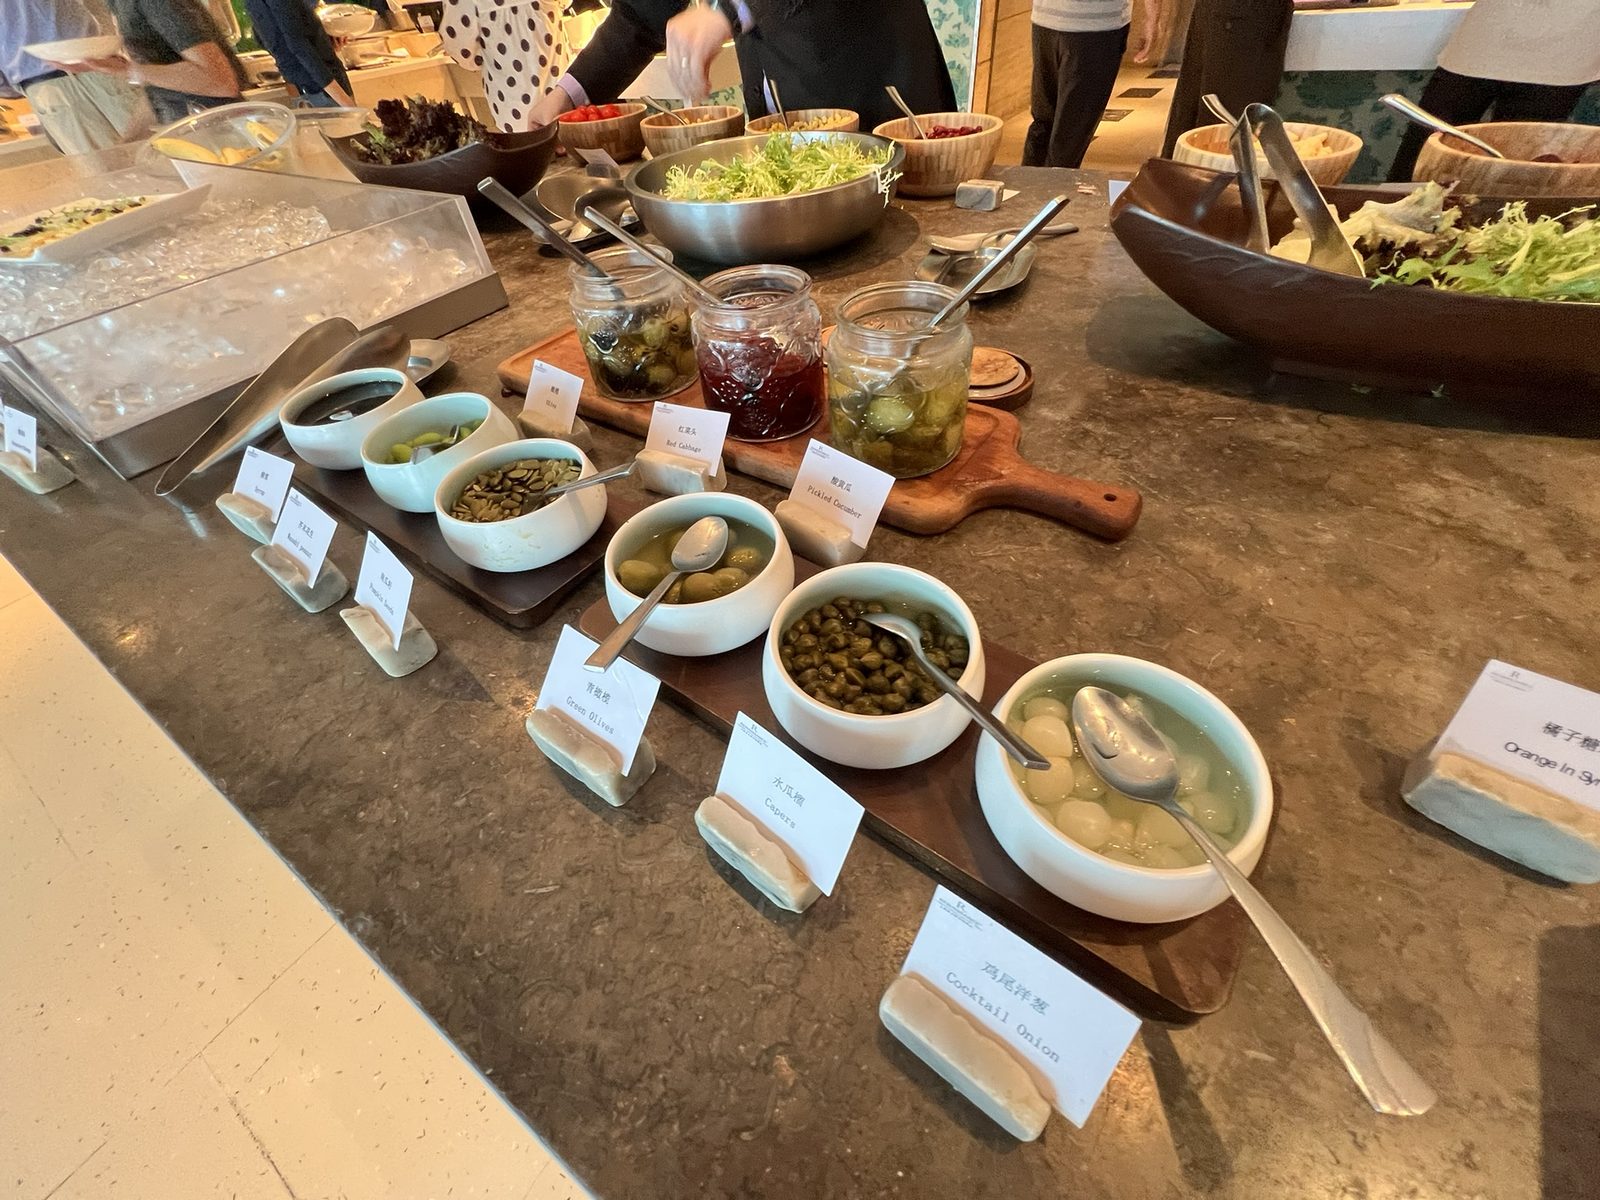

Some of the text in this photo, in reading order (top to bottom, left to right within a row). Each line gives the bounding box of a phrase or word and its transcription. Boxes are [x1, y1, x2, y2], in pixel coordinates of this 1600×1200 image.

[666, 439, 702, 453] Red Cabbage
[807, 485, 862, 519] Pickled Cucumber
[566, 696, 615, 735] Green Olives
[1504, 742, 1558, 768] Orange
[1560, 763, 1576, 777] In
[764, 798, 796, 829] Capers
[946, 972, 1060, 1064] Cocktail Onion
